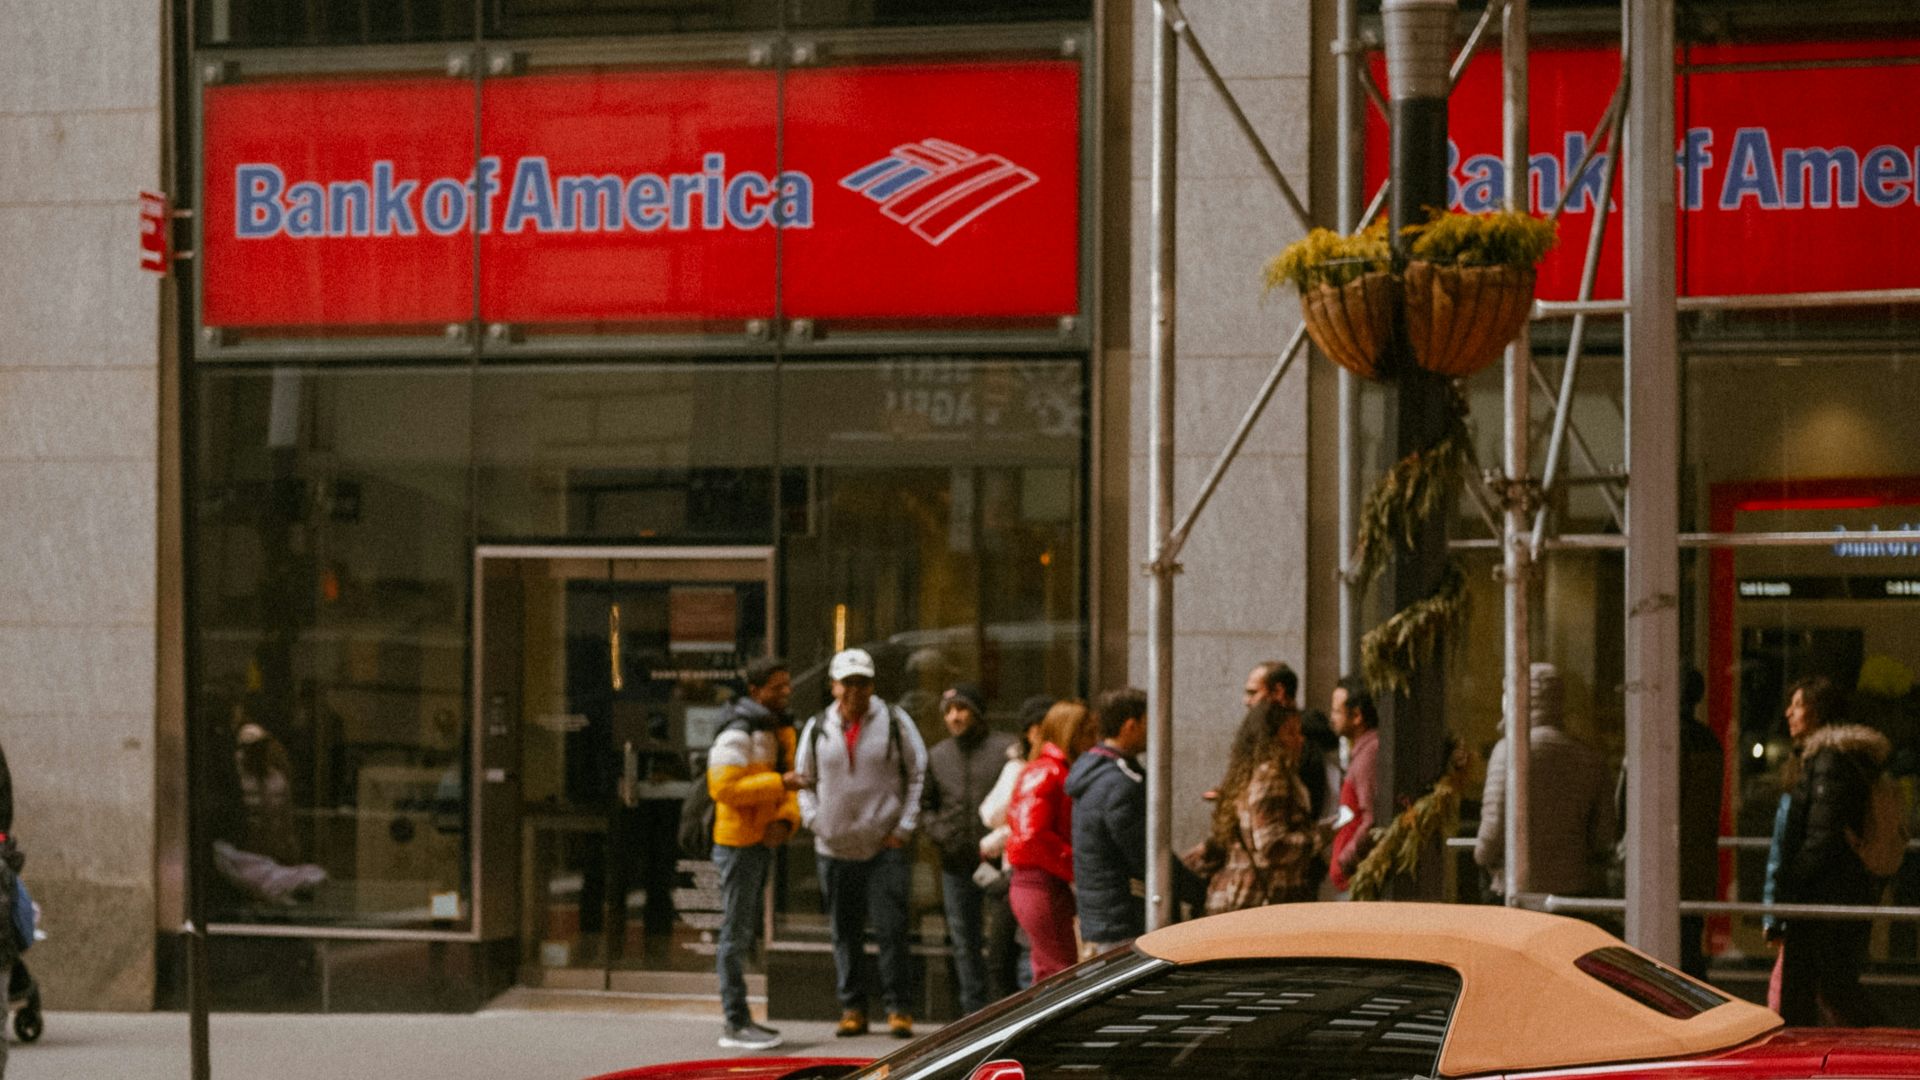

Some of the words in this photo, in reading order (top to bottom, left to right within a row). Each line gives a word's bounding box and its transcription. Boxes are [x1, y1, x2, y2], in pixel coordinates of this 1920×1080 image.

[235, 160, 419, 238] Bank
[422, 156, 500, 236] of
[503, 153, 813, 234] America
[1447, 131, 1617, 214] ank
[1676, 127, 1714, 211] f
[1718, 127, 1920, 211] Ame
